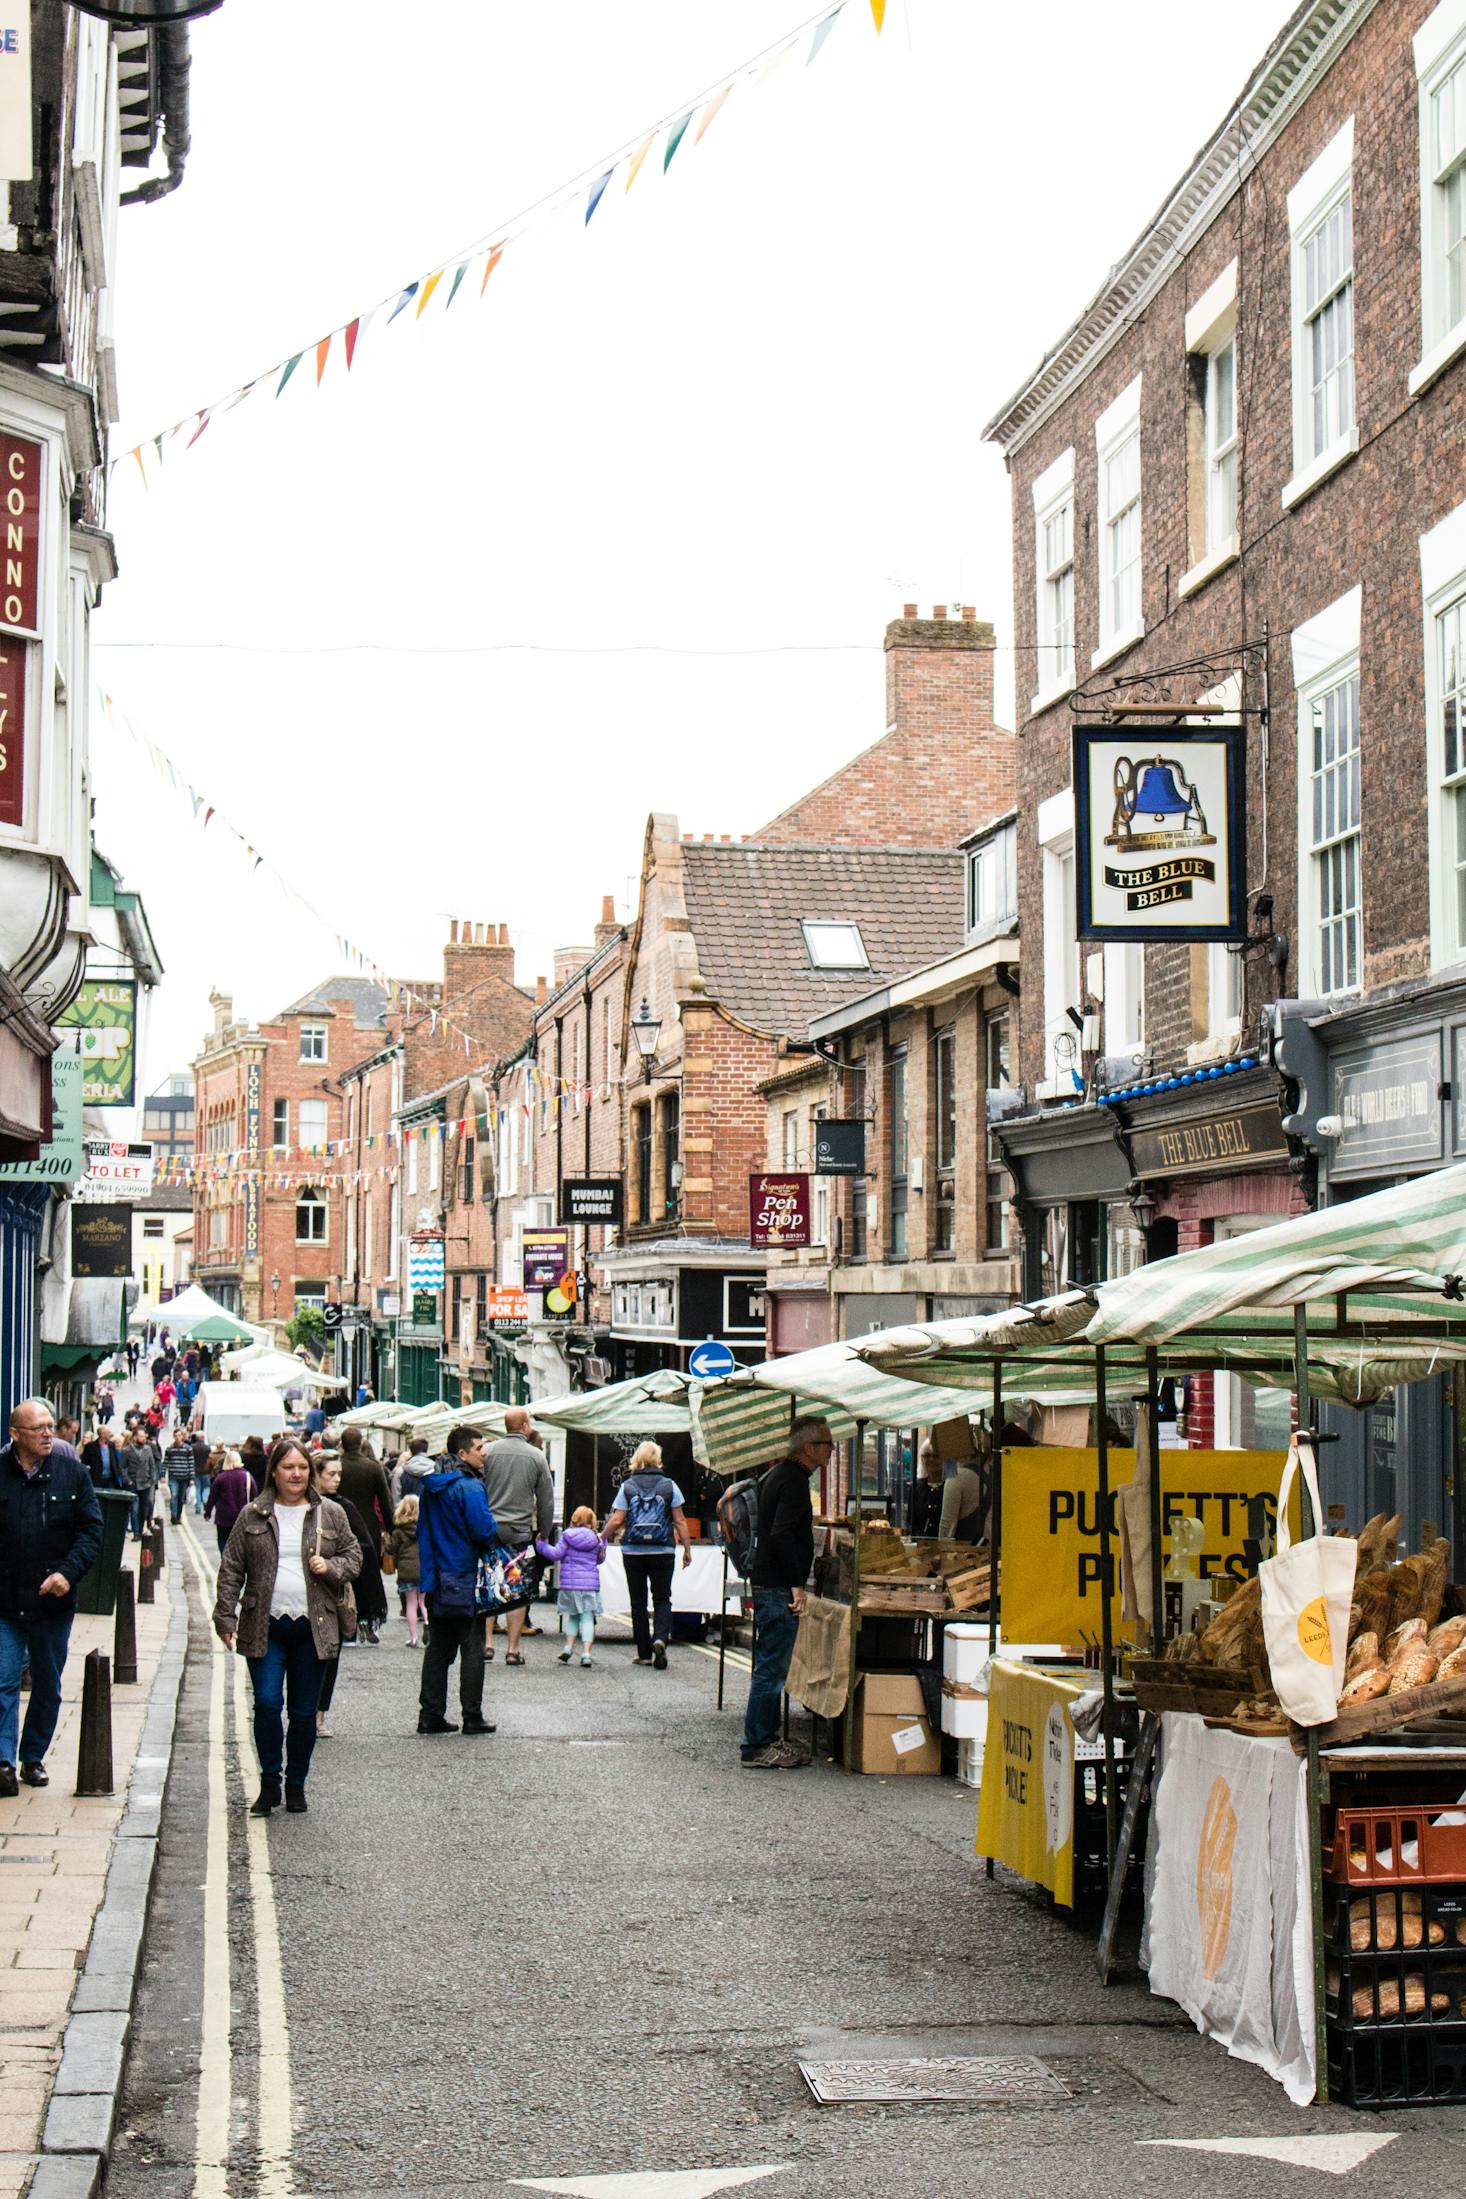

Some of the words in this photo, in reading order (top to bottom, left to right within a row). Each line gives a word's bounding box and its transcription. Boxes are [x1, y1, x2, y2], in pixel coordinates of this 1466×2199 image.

[0, 29, 18, 53] E
[1114, 869, 1153, 886] THE
[1158, 861, 1205, 880] BLUE
[1137, 885, 1183, 908] BELL
[94, 987, 131, 1003] ALE
[248, 1065, 259, 1109] LOCH
[1158, 1133, 1185, 1165] THE
[1184, 1125, 1217, 1160] BLUE
[1215, 1120, 1250, 1156] BELL
[90, 1165, 109, 1177] TO
[115, 1167, 141, 1178] LET
[571, 1189, 614, 1201] MUMBAI
[763, 1197, 797, 1210] Pen
[573, 1203, 612, 1215] LOUNGE
[756, 1211, 804, 1229] Shop
[490, 1303, 512, 1317] FOR
[1049, 1490, 1277, 1536] PUCETT'S
